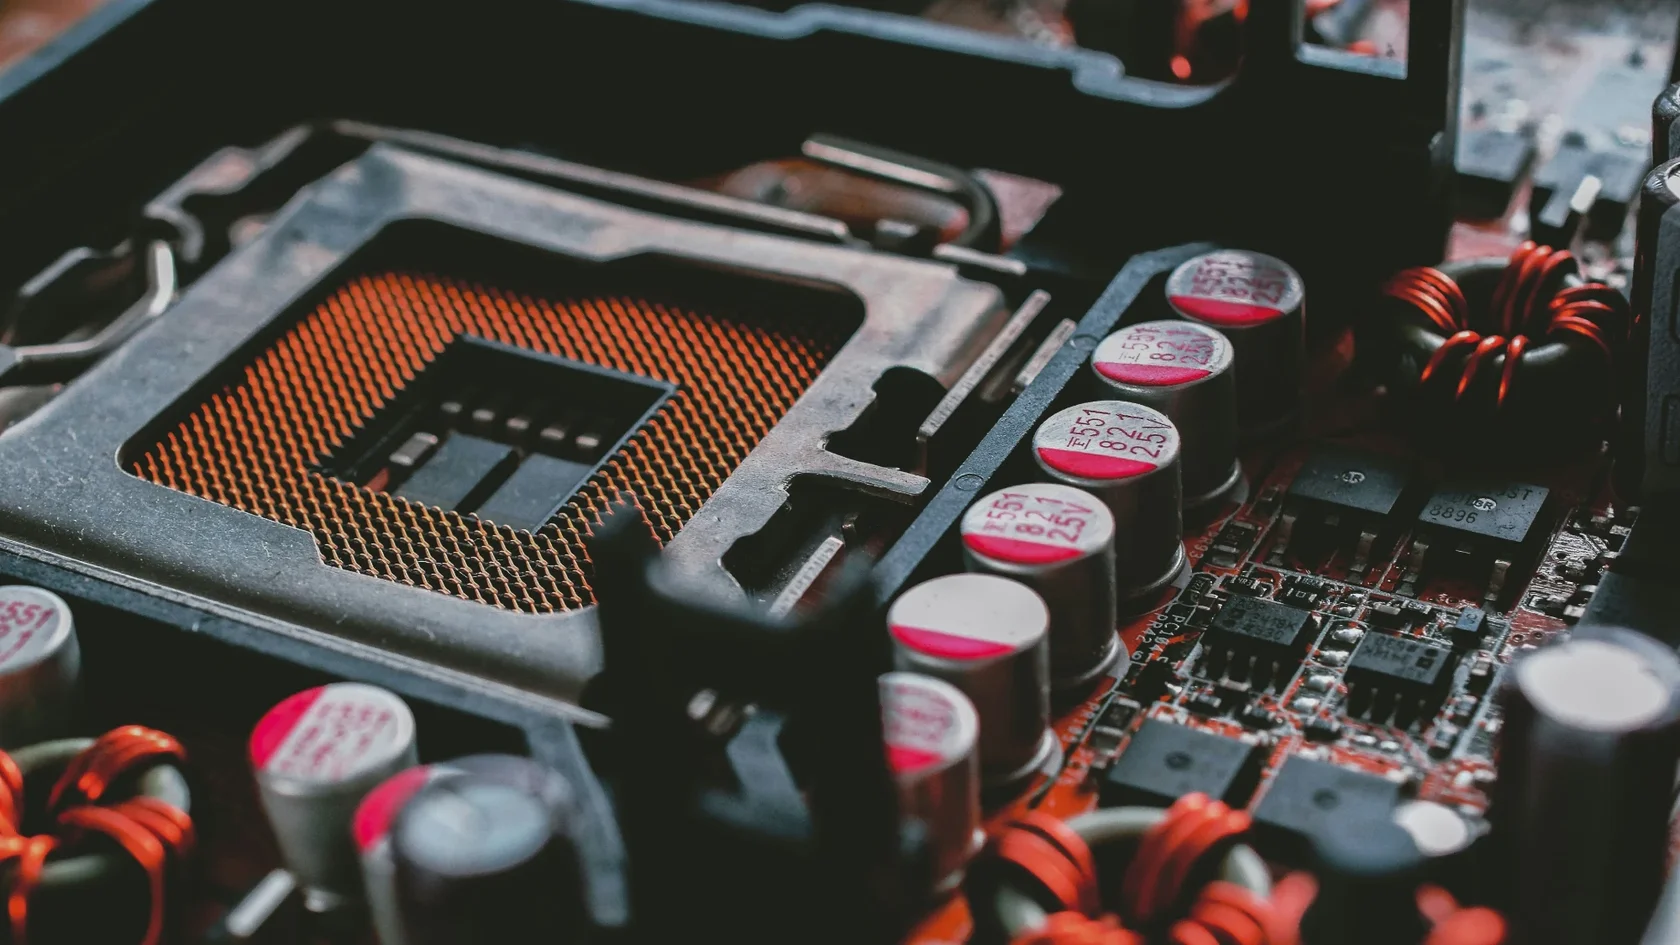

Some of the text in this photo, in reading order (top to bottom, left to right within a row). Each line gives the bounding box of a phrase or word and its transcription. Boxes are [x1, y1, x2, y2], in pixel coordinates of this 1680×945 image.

[1149, 329, 1192, 361] 821
[1099, 413, 1144, 451] 821
[1130, 418, 1172, 458] 2.5V
[1015, 496, 1063, 536] 821
[1429, 504, 1478, 524] 8896
[1136, 612, 1169, 644] PR42
